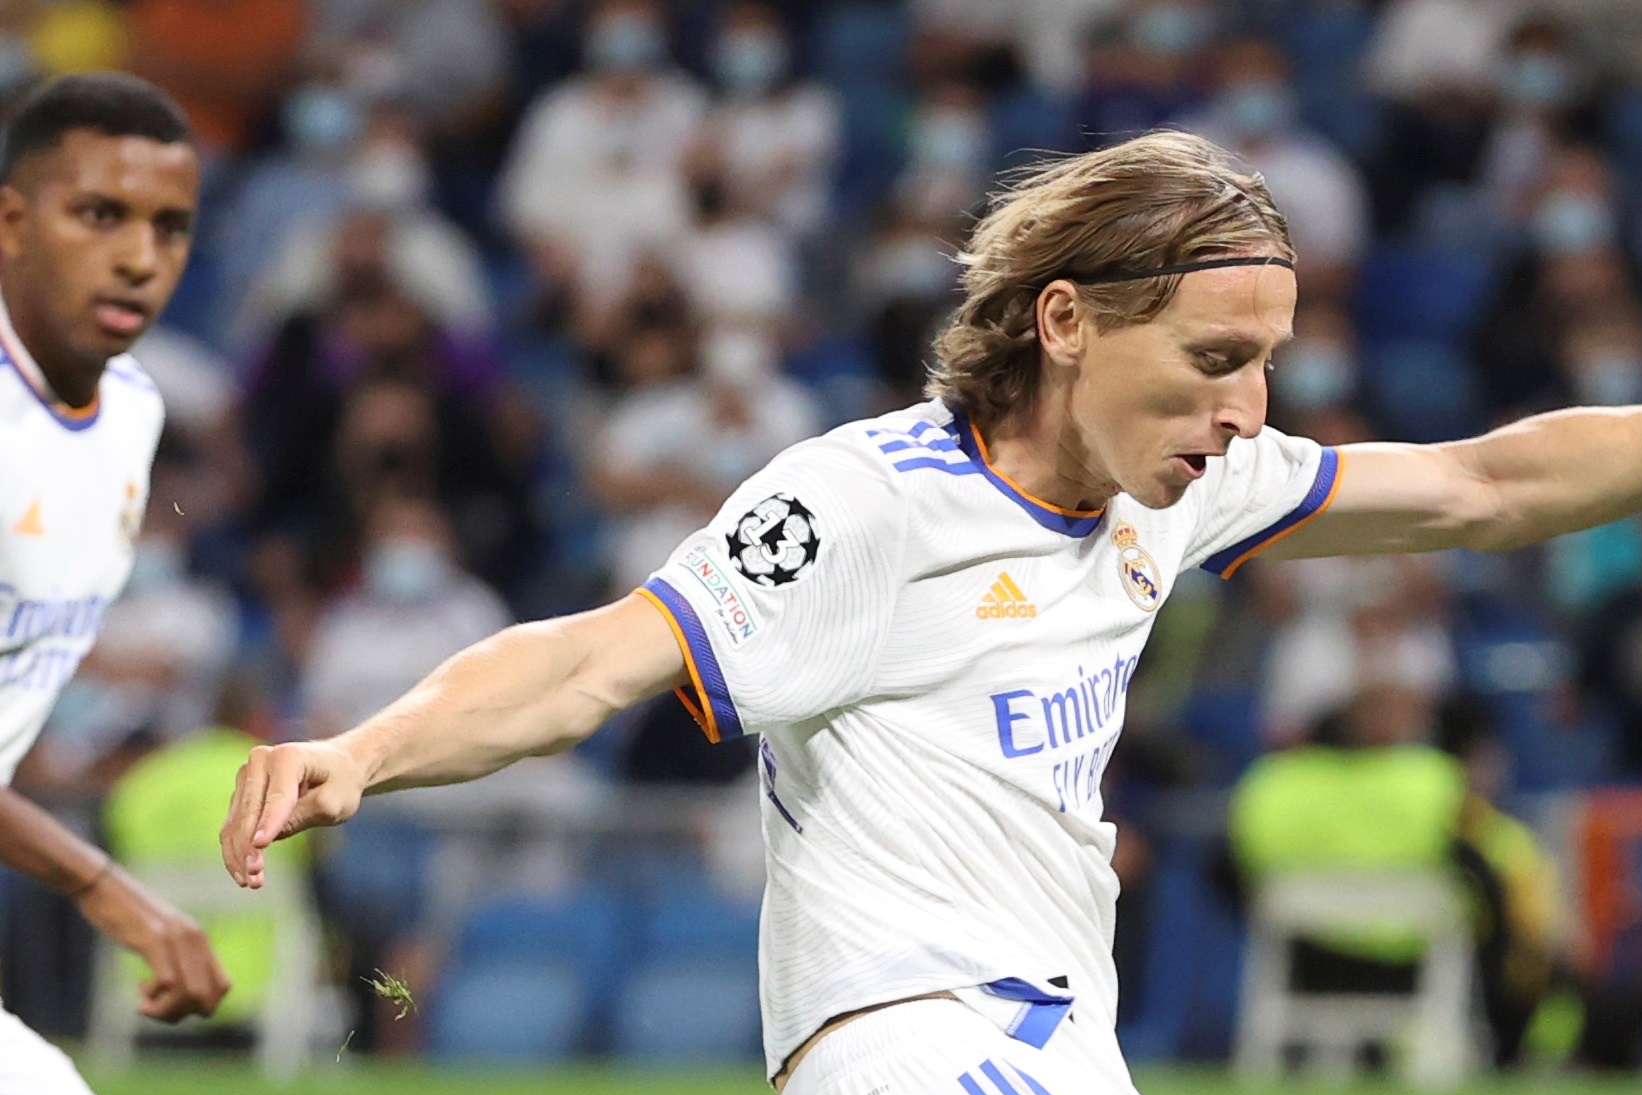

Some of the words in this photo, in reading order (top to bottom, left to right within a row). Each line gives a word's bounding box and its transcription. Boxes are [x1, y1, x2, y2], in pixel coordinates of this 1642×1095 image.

[743, 510, 801, 565] 13
[975, 601, 1037, 620] adidas
[989, 651, 1138, 759] Emirate
